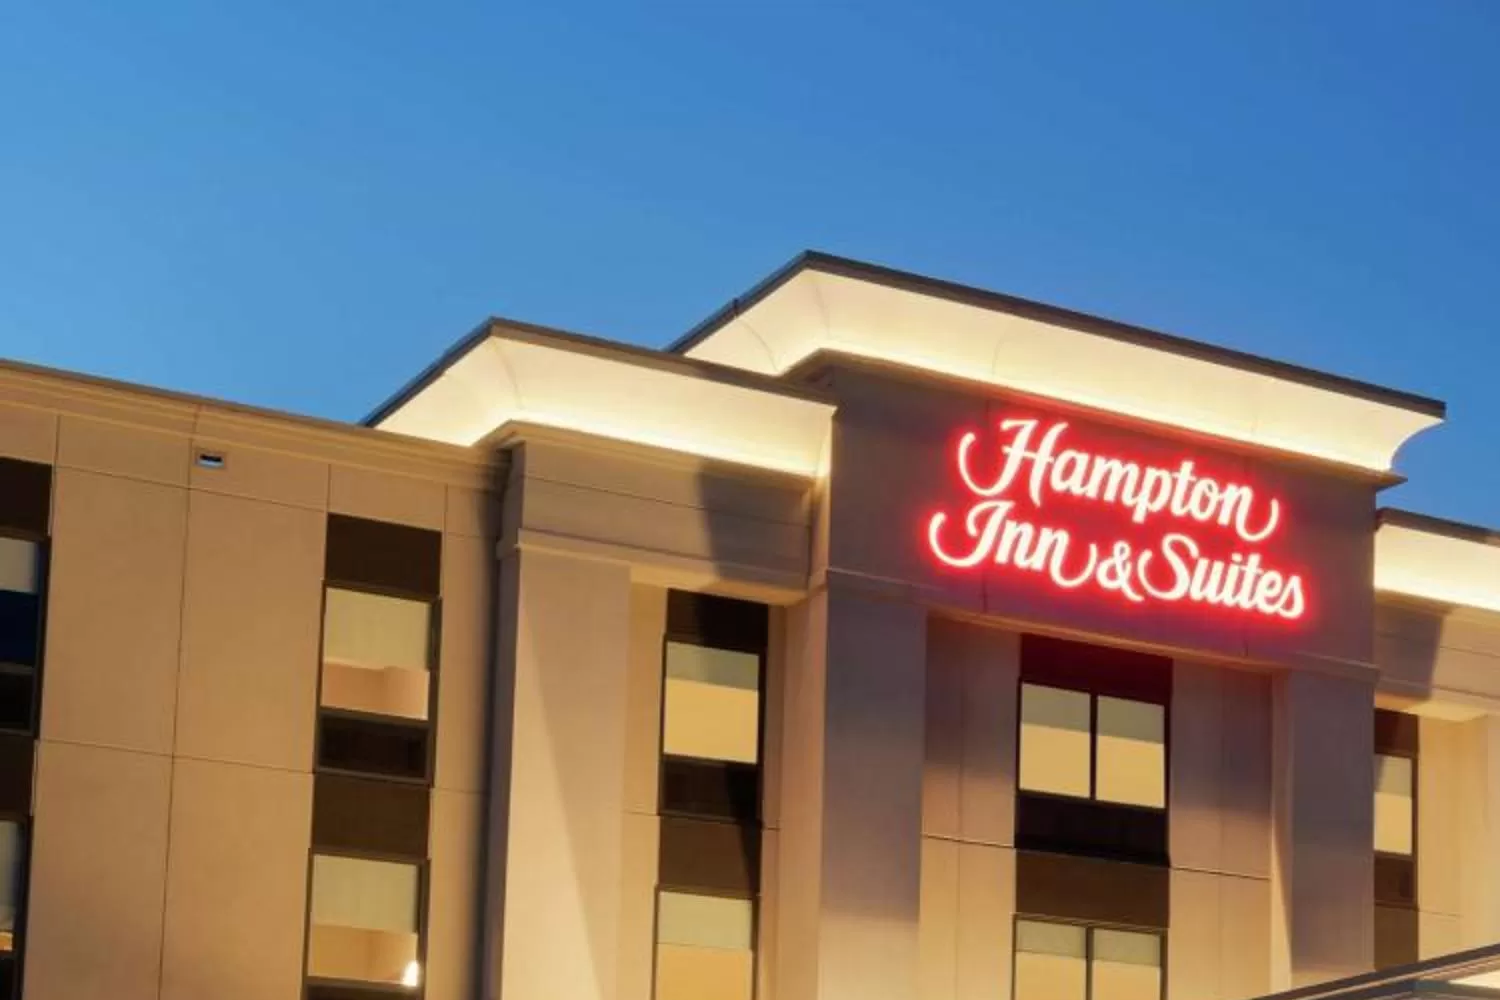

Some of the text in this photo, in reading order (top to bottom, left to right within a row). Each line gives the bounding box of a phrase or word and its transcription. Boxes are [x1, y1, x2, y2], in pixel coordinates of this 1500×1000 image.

[958, 419, 1279, 541] Hampton
[928, 501, 1304, 619] Inn & Suites
